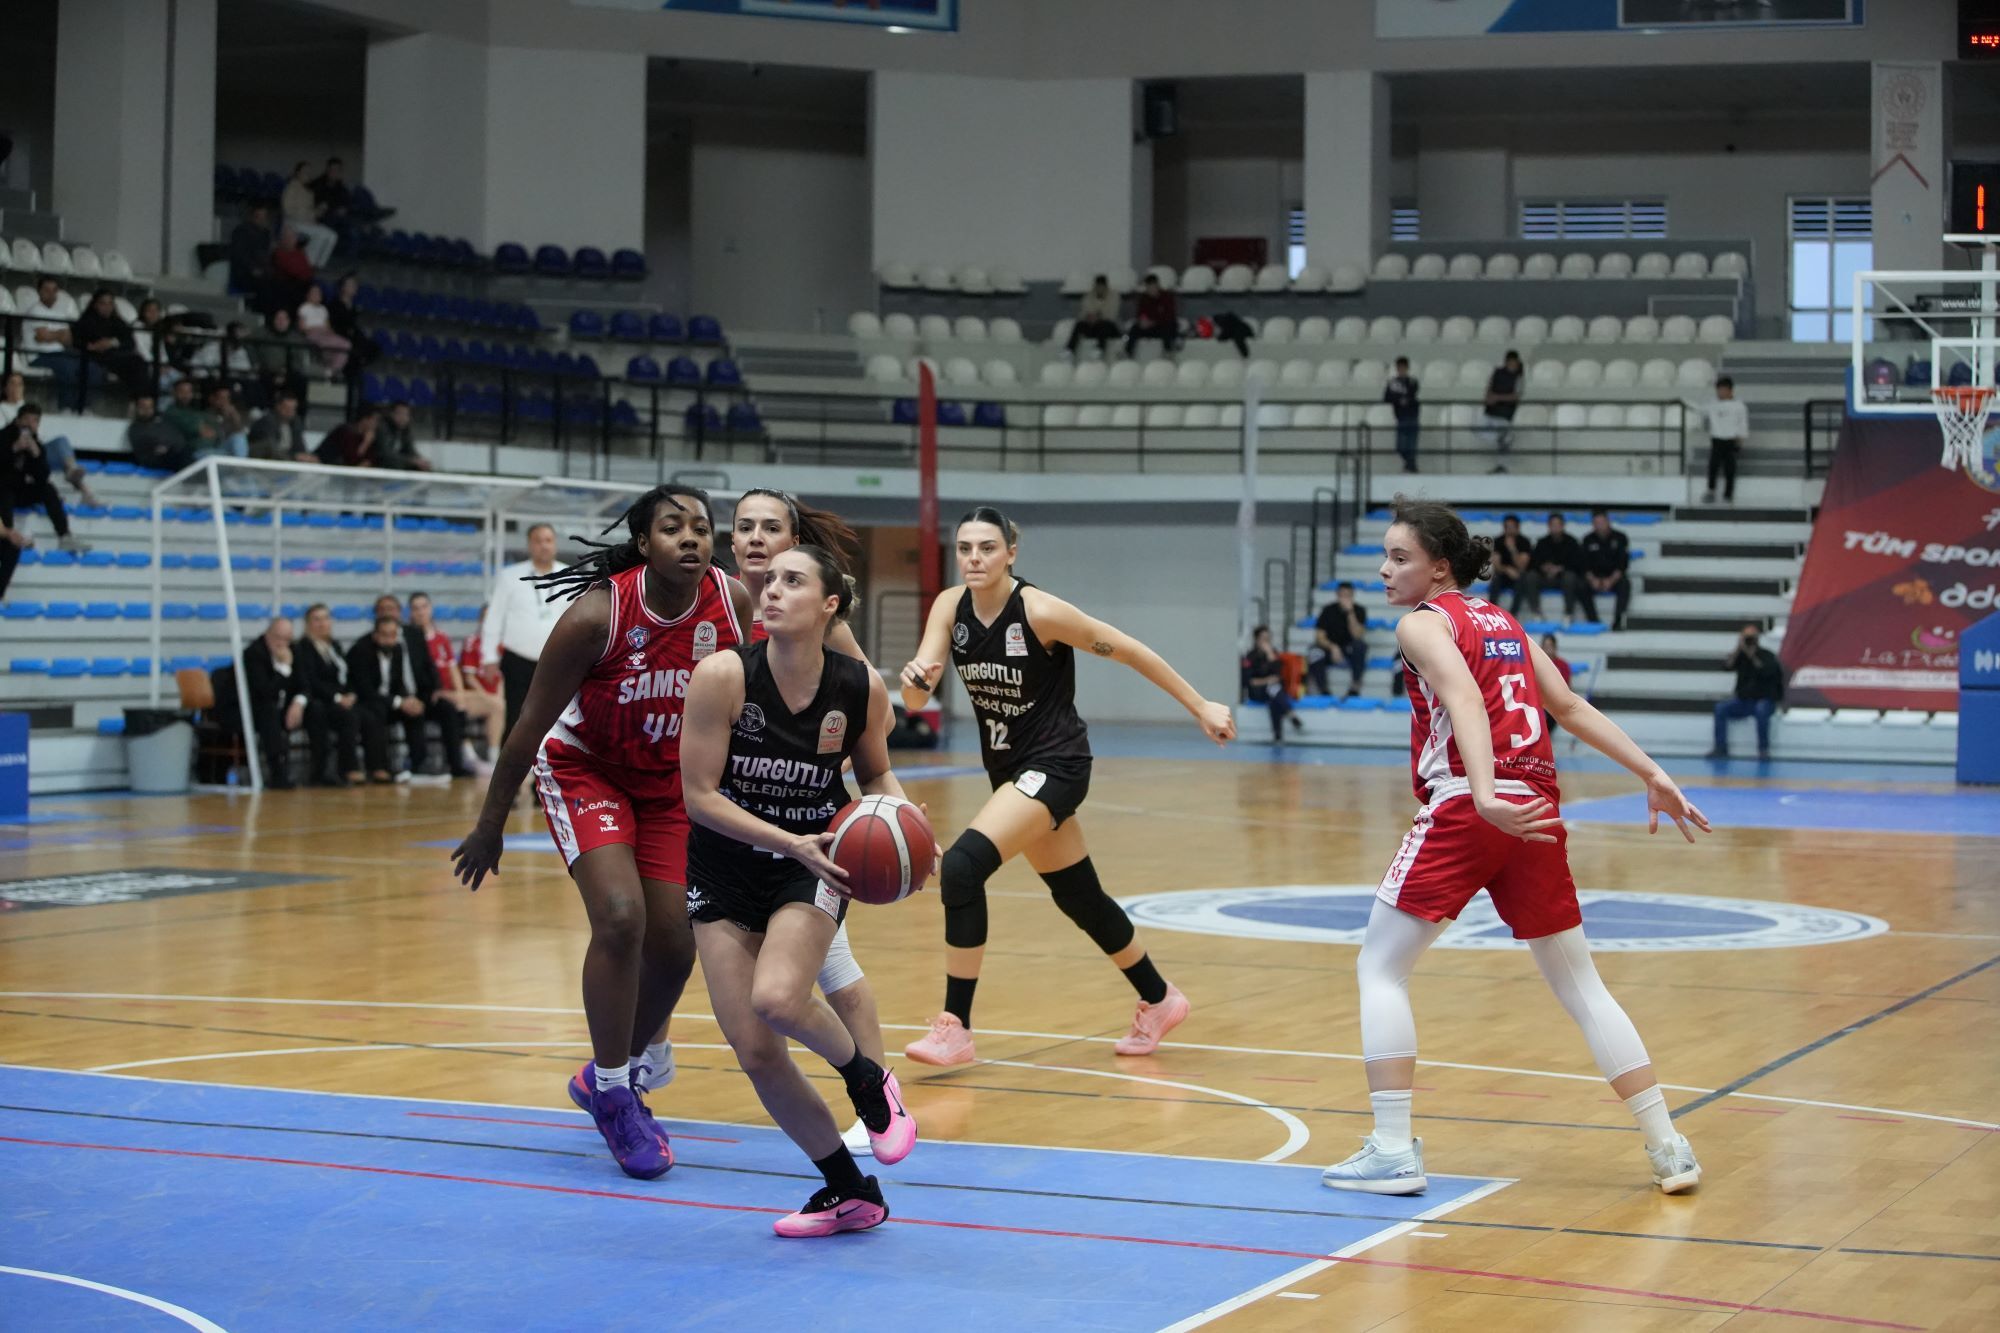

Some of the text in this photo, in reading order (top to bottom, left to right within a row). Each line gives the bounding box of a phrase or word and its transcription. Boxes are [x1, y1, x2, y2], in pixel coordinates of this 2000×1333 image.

[1844, 530, 1917, 559] TÜM
[957, 662, 1023, 686] TURGUTLU
[1498, 672, 1541, 748] 5
[985, 718, 1011, 751] 12
[731, 755, 834, 789] TURGUTLU
